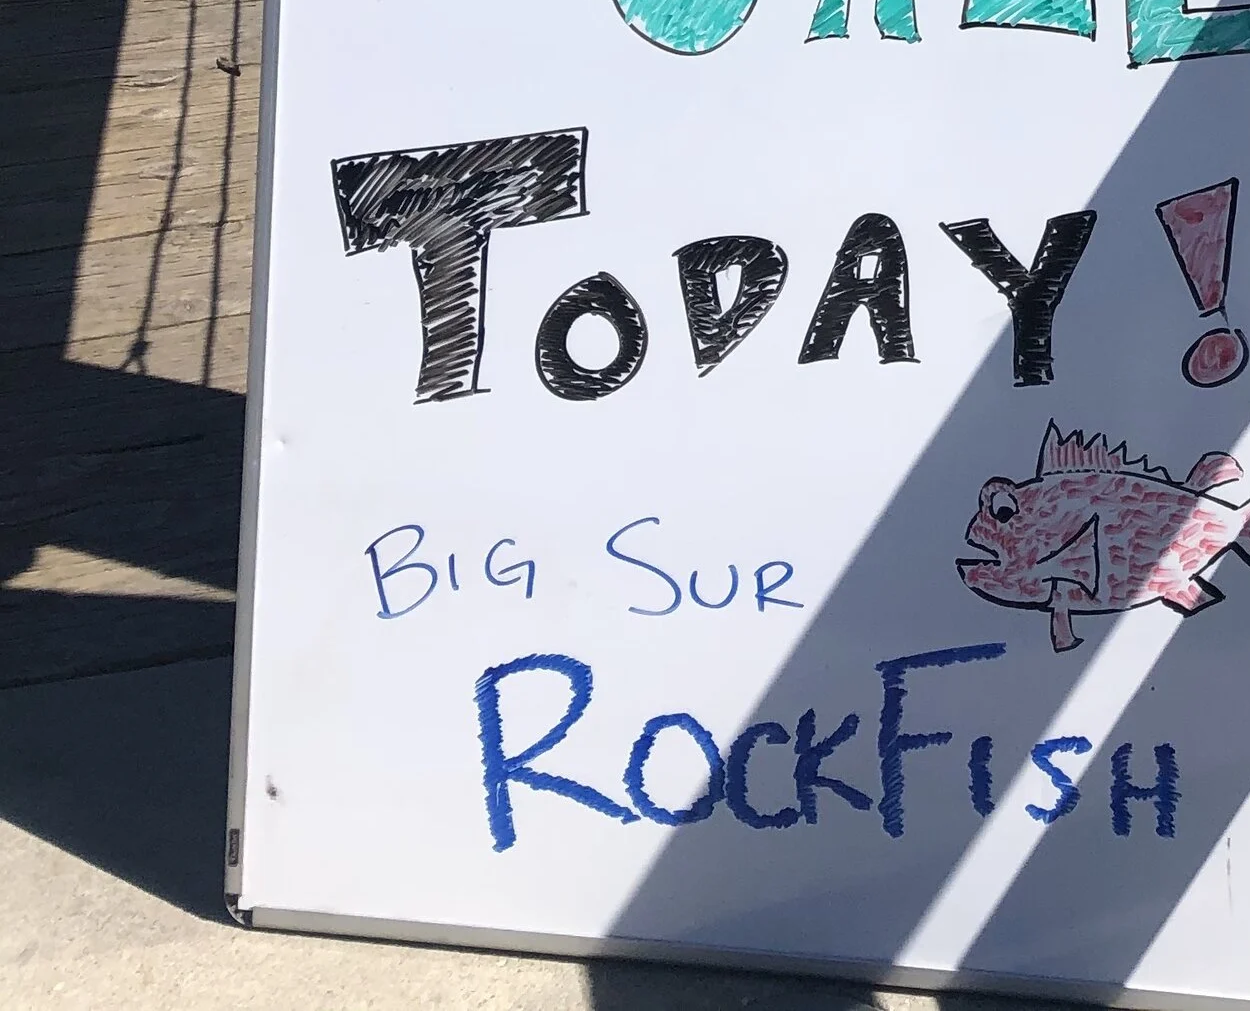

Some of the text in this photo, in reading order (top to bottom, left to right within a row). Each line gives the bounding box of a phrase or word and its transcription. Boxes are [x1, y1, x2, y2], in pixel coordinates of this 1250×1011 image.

[366, 517, 805, 619] BIG SUR
[474, 642, 1180, 852] ROCKFISH
